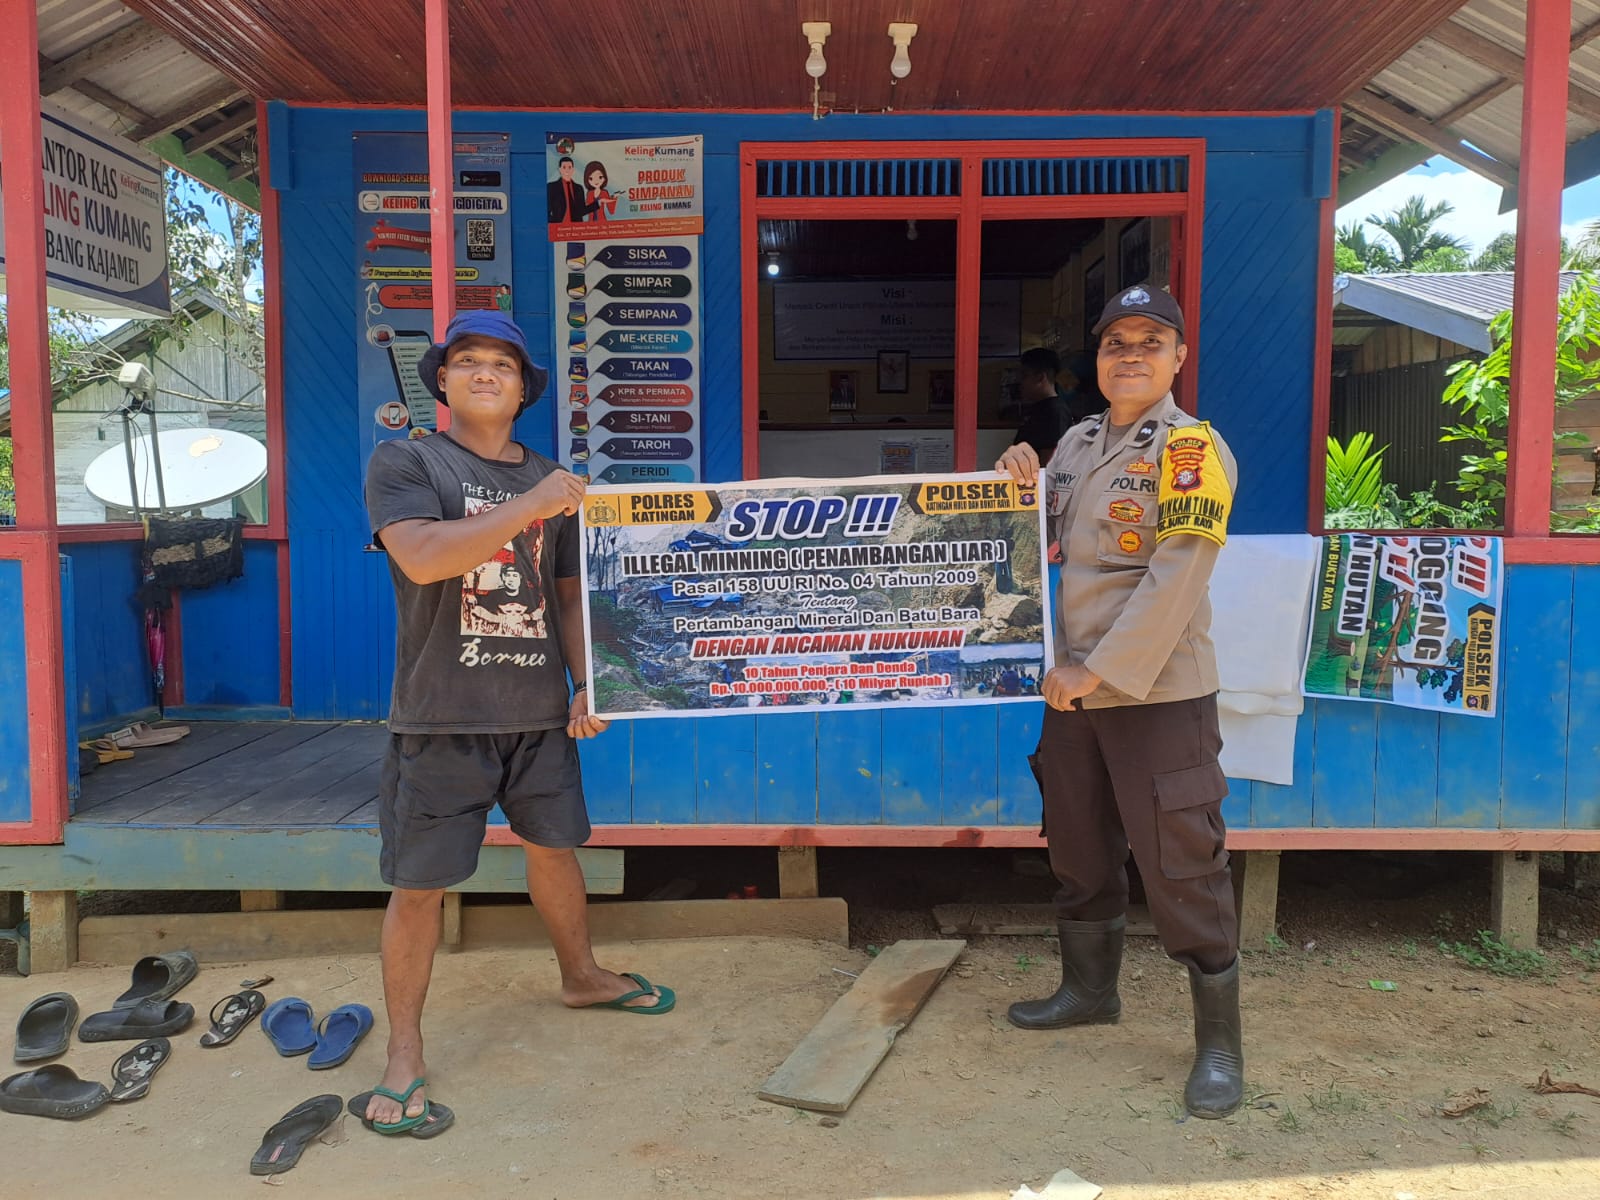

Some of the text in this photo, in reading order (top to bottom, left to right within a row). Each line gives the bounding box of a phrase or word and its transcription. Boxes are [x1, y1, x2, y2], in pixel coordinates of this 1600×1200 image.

[625, 146, 694, 157] KelingKumang
[90, 158, 118, 200] KAS
[638, 169, 686, 183] PRODUK
[628, 185, 695, 202] SIMPANAN
[382, 197, 417, 210] KELING
[465, 198, 503, 210] DIGITAL
[629, 201, 692, 212] CU KELING KUMANG
[85, 196, 152, 253] KUMANG
[628, 249, 667, 260] SISKA
[87, 244, 140, 286] KAJAMEI
[624, 277, 672, 288] SIMPAR
[881, 288, 905, 298] Visi
[619, 309, 677, 319] SEMPANA
[880, 314, 905, 325] Misi
[619, 333, 679, 343] ME-KEREN
[630, 361, 669, 371] TAKAN
[618, 388, 635, 396] KPR
[630, 414, 671, 423] SI-TANI
[631, 440, 671, 449] TAROH
[631, 467, 669, 476] PERIDI
[462, 482, 485, 497] THE
[927, 483, 1009, 501] POLSEK
[1111, 477, 1157, 494] POLRI
[631, 494, 694, 510] POLRES
[926, 501, 953, 511] KATINGAN
[968, 500, 979, 510] DAN
[631, 510, 695, 523] KATINGAN
[1194, 516, 1213, 531] RAYA
[624, 554, 697, 575] ILLEGAL
[702, 550, 786, 573] MINNING
[1327, 553, 1340, 585] BUKIT
[674, 571, 977, 595] Pasal 158 UU RI No. 04 Tahun 2009
[1321, 586, 1335, 611] RAYA
[1341, 554, 1372, 632] HUTAN
[801, 594, 857, 610] Tentang
[675, 608, 979, 632] Pertambangan Mineral Dan Batu Bara
[693, 630, 964, 658] DENGAN ANCAMAN HUKUMAN
[459, 638, 546, 667] Borneo
[1476, 619, 1492, 687] POLSEK
[745, 662, 915, 679] 10 Tahun Penjara Dan Denda
[711, 684, 732, 695] Rp.
[859, 677, 896, 690] Milyar
[900, 675, 940, 688] Rupiah
